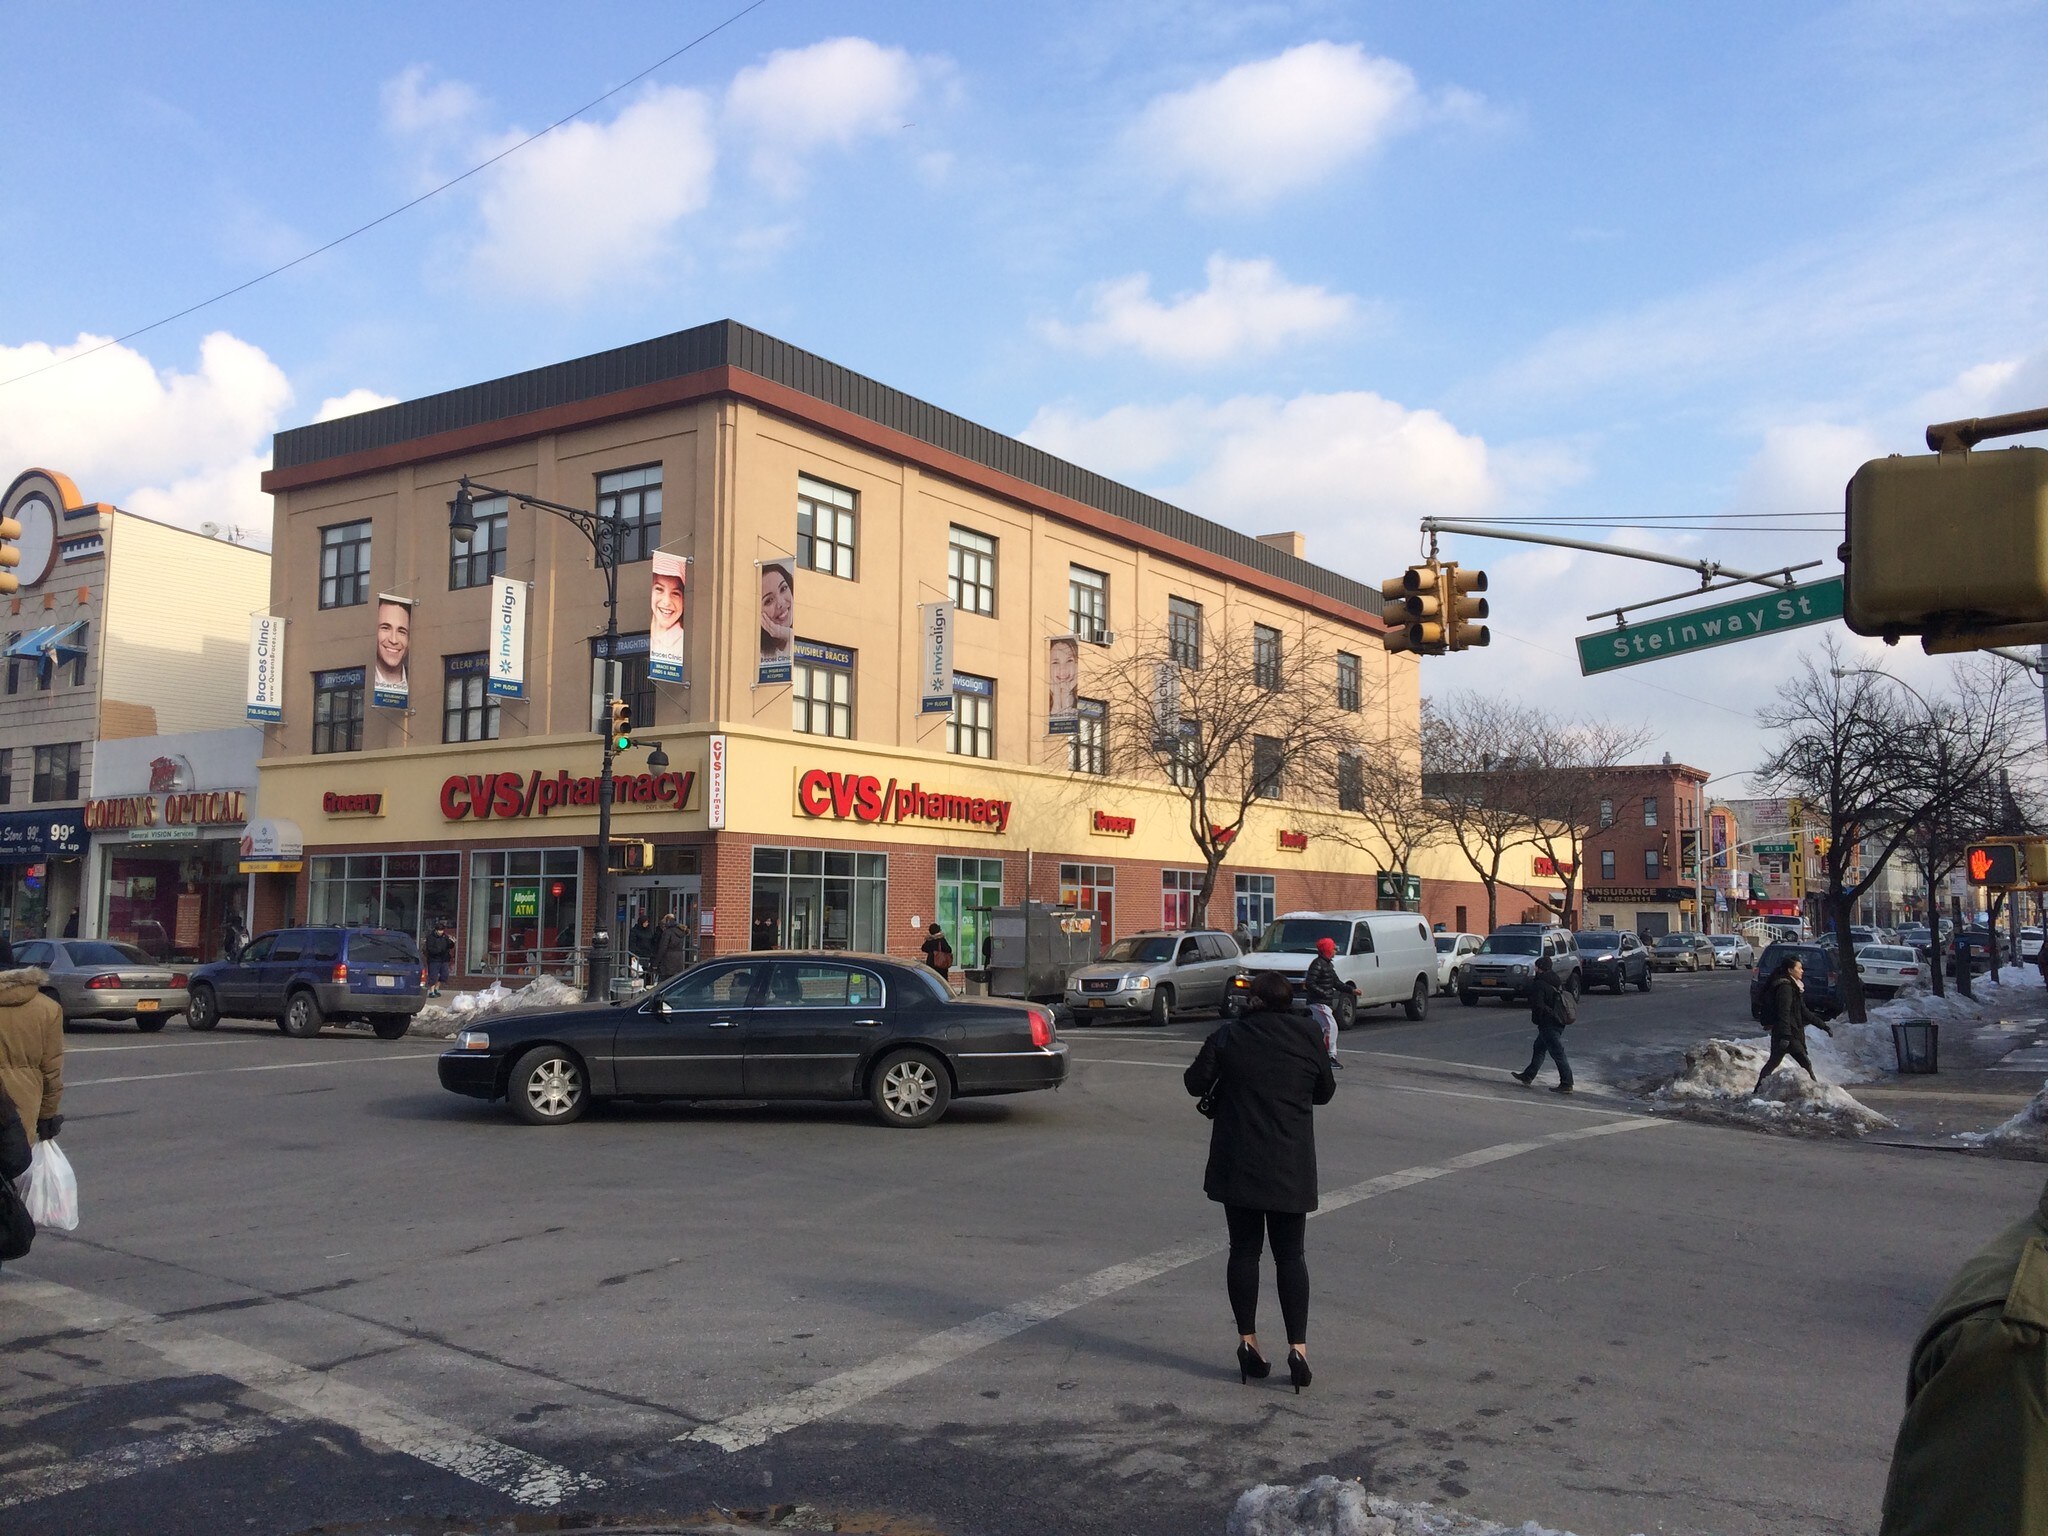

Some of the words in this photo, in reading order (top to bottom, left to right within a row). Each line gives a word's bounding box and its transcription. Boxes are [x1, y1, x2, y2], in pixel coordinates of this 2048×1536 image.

[500, 586, 516, 658] invisalign
[1613, 609, 1764, 657] Steinway
[1777, 595, 1812, 620] St
[258, 620, 270, 657] Clinic
[615, 638, 649, 651] TRAIGHTEN
[794, 644, 823, 658] NVISIBLE
[825, 651, 849, 663] BRACES
[933, 607, 946, 675] invisalign
[256, 659, 268, 702] Braces
[953, 675, 984, 692] nvisalign
[713, 741, 722, 771] CVS
[84, 796, 157, 829] COHEN'S
[165, 790, 247, 825] OPTICAL
[323, 791, 384, 815] Grocery
[440, 769, 696, 820] CVS/pharmacy
[799, 768, 1012, 835] CVS/pharmacy
[3, 826, 23, 842] Store
[68, 843, 79, 852] up
[173, 830, 194, 838] Services
[1791, 806, 1803, 899] INFINITI
[1591, 888, 1657, 896] INSURANCE
[515, 904, 534, 915] ATM
